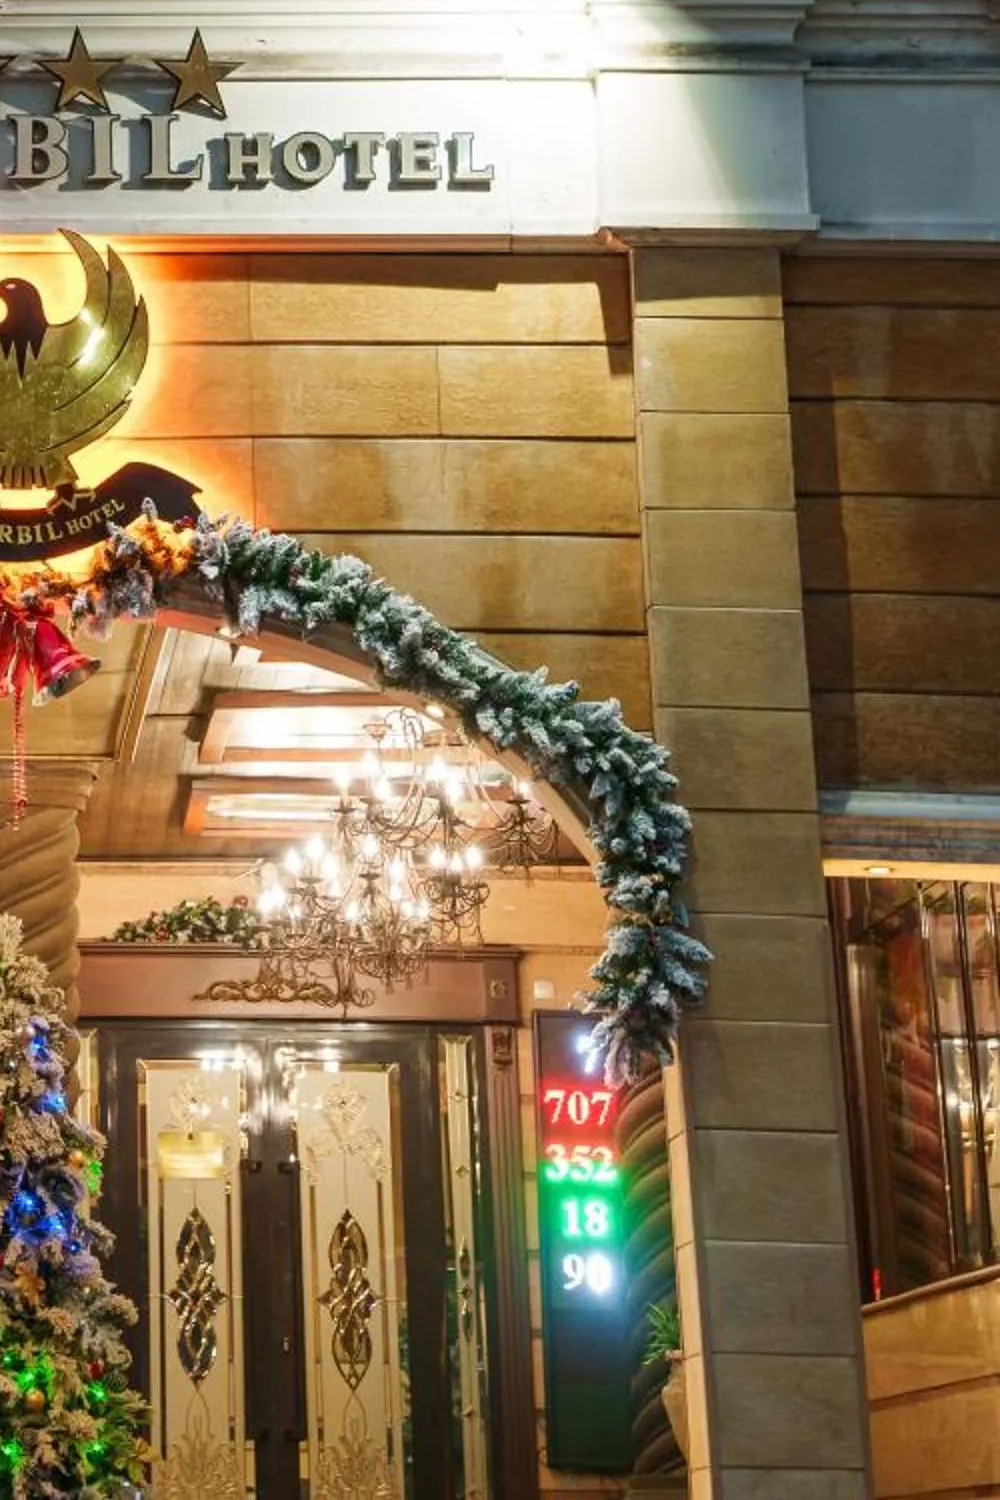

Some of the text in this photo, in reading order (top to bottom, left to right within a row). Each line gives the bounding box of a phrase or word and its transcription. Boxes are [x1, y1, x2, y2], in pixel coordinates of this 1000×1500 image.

[224, 131, 494, 184] HOTEL
[65, 499, 126, 536] HOTEL
[543, 1089, 613, 1125] 707
[544, 1143, 618, 1182] 352
[561, 1200, 609, 1238] 18
[562, 1253, 613, 1293] 90
